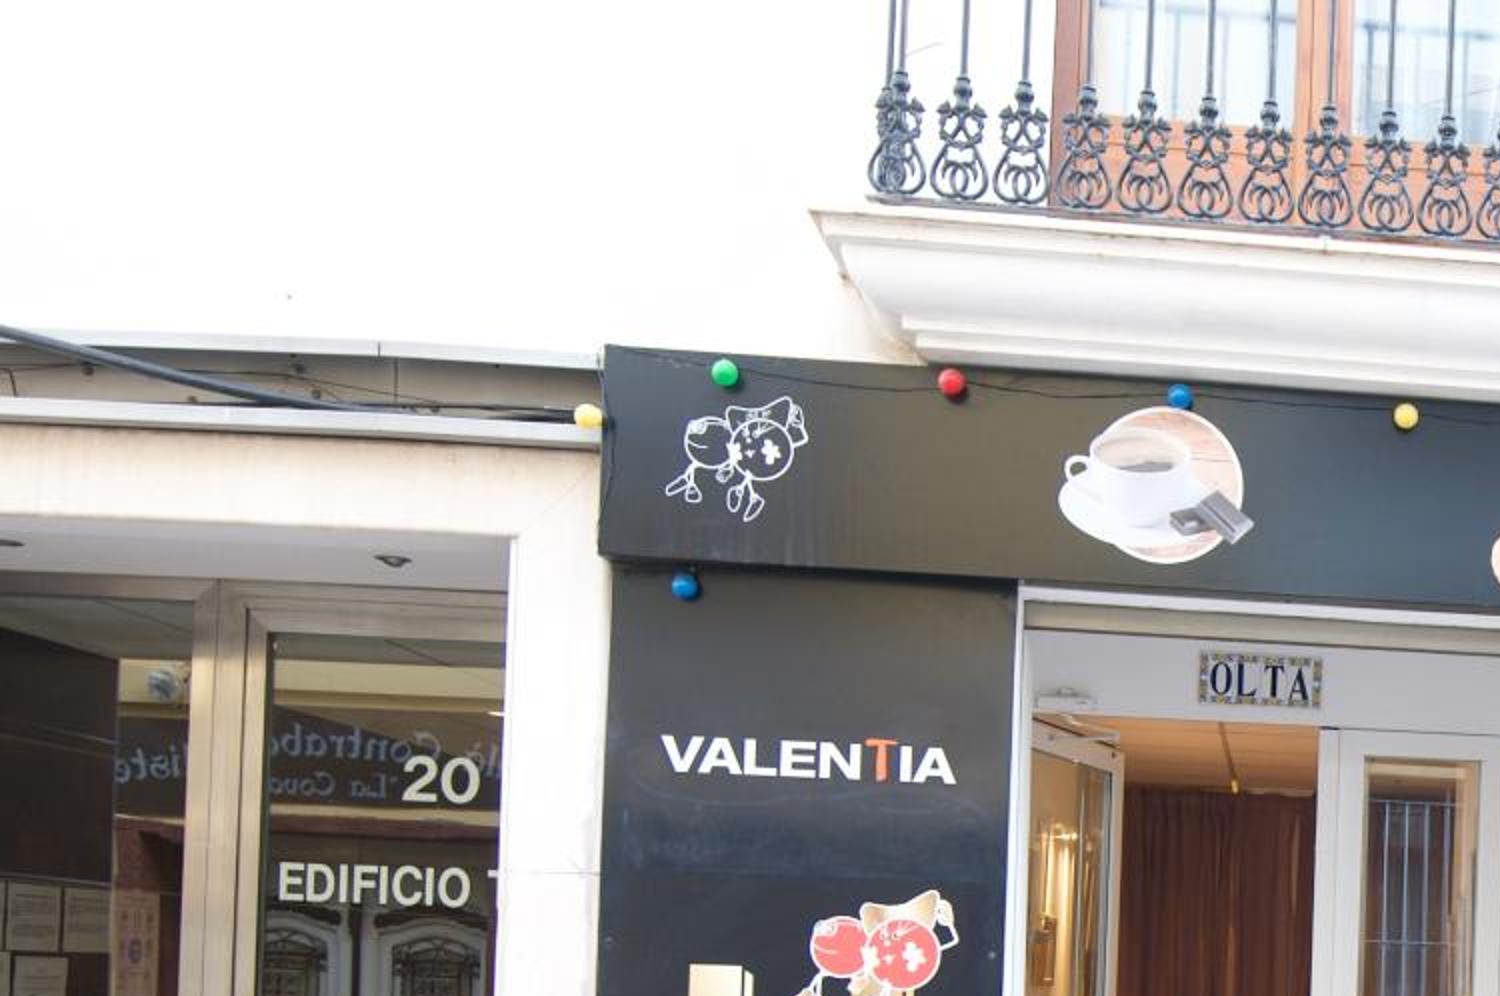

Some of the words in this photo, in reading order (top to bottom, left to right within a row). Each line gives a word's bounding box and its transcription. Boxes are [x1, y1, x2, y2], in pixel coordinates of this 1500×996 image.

[1209, 661, 1310, 702] OLTA
[401, 755, 481, 805] 20
[660, 733, 957, 785] VALENTIA
[278, 861, 472, 909] EDIFICIO
